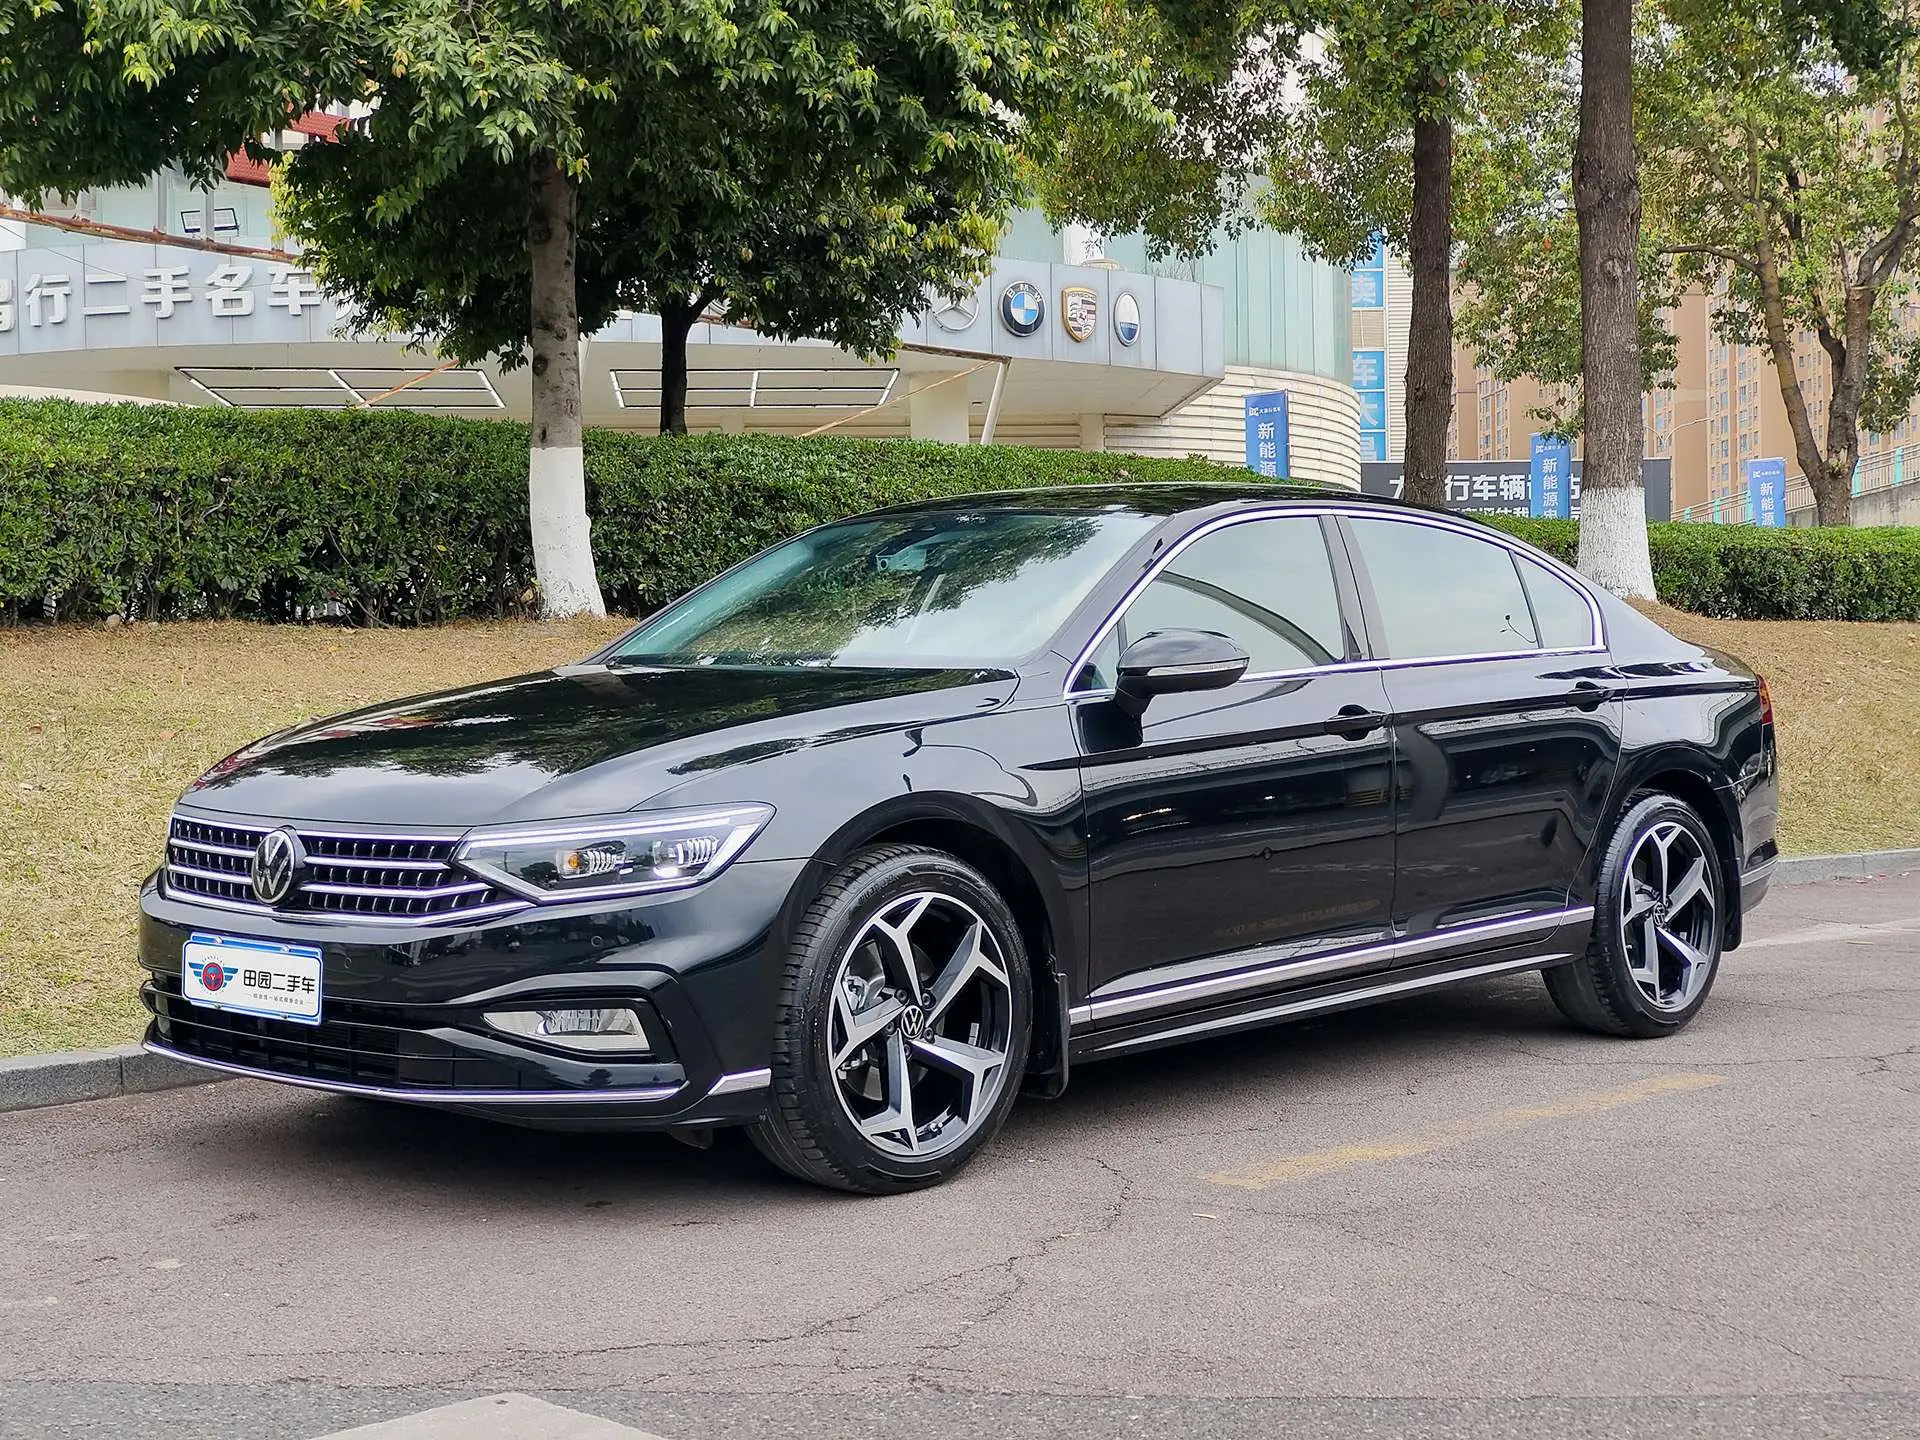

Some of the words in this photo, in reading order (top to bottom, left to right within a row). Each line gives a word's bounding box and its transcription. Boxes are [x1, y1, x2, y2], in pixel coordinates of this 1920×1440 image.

[0, 263, 356, 331] 行二手名车
[1007, 284, 1042, 303] BMW
[1258, 422, 1277, 477] 新能源
[1760, 481, 1775, 526] 新能源
[254, 831, 293, 901] VW
[243, 969, 315, 994] 田园二手车
[902, 1006, 924, 1037] VW
